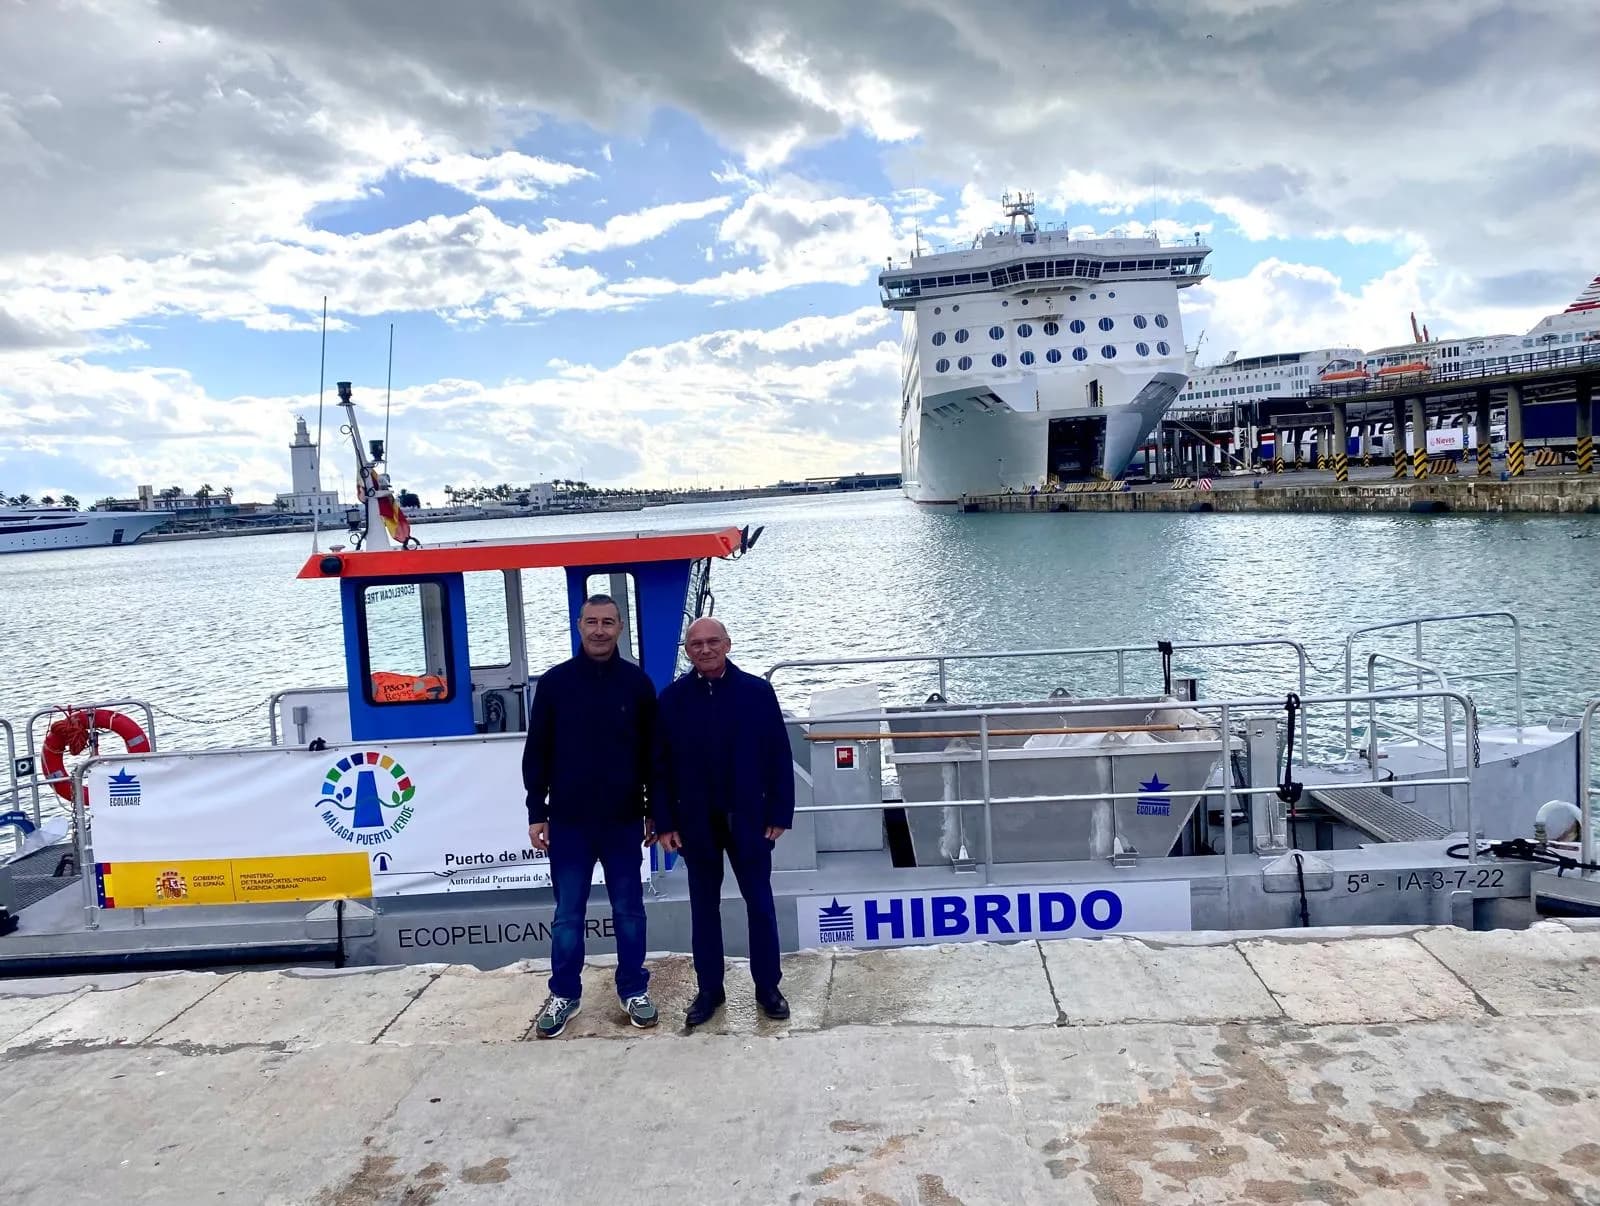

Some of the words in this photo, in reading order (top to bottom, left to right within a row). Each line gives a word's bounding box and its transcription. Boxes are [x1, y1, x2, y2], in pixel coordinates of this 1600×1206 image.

[109, 796, 141, 807] ECOLMARE
[1136, 805, 1170, 817] ECOLMARE
[321, 810, 354, 843] MÁLAGA
[356, 829, 393, 846] PUERTO
[390, 805, 415, 834] VERDE
[445, 852, 495, 866] Puerto
[498, 850, 517, 862] de
[521, 848, 549, 860] Mál
[449, 876, 490, 886] Autoridad
[492, 873, 531, 884] Portuaria
[533, 873, 543, 881] de
[864, 889, 1123, 940] HIBRIDO
[398, 921, 553, 948] ECOPELICAN
[585, 919, 616, 938] RE
[820, 930, 855, 943] ECOLMARE
